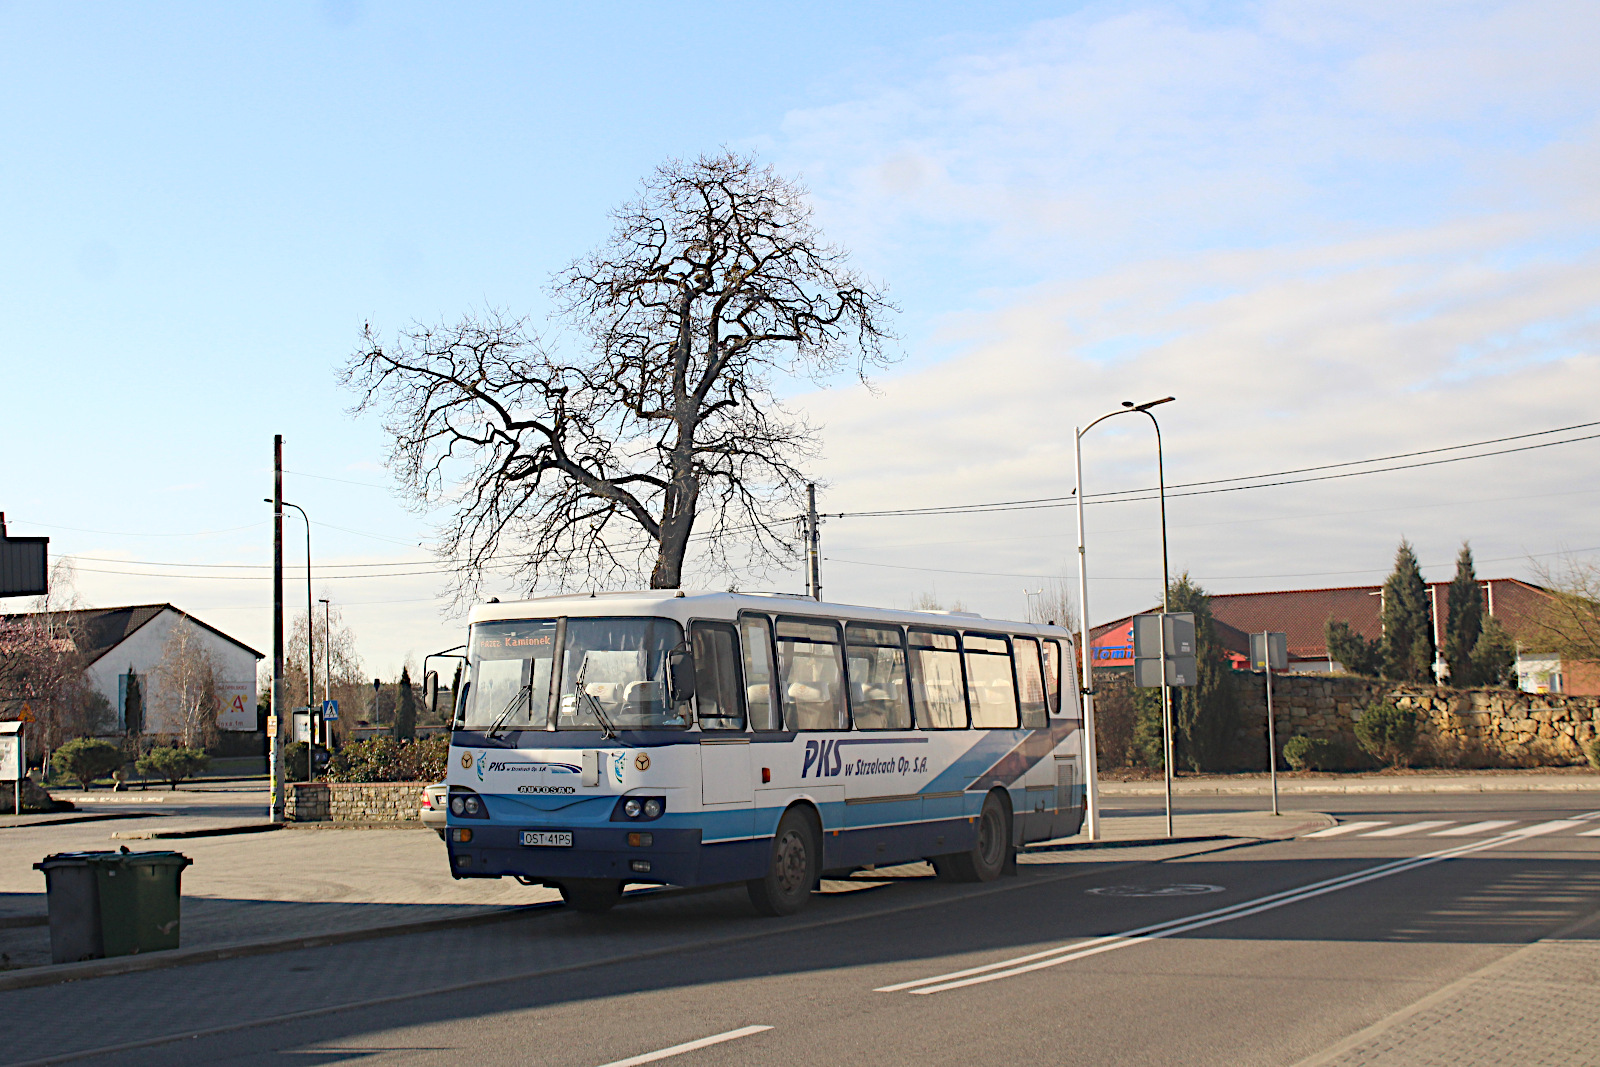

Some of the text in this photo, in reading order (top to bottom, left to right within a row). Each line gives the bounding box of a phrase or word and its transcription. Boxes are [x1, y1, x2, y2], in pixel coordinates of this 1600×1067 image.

[505, 635, 551, 647] Kamionek
[801, 739, 928, 779] PKS w Strzelcach Op. S.A.
[488, 761, 506, 772] PKS
[519, 785, 574, 794] AUTOSAN
[525, 833, 571, 845] OST 41PS
